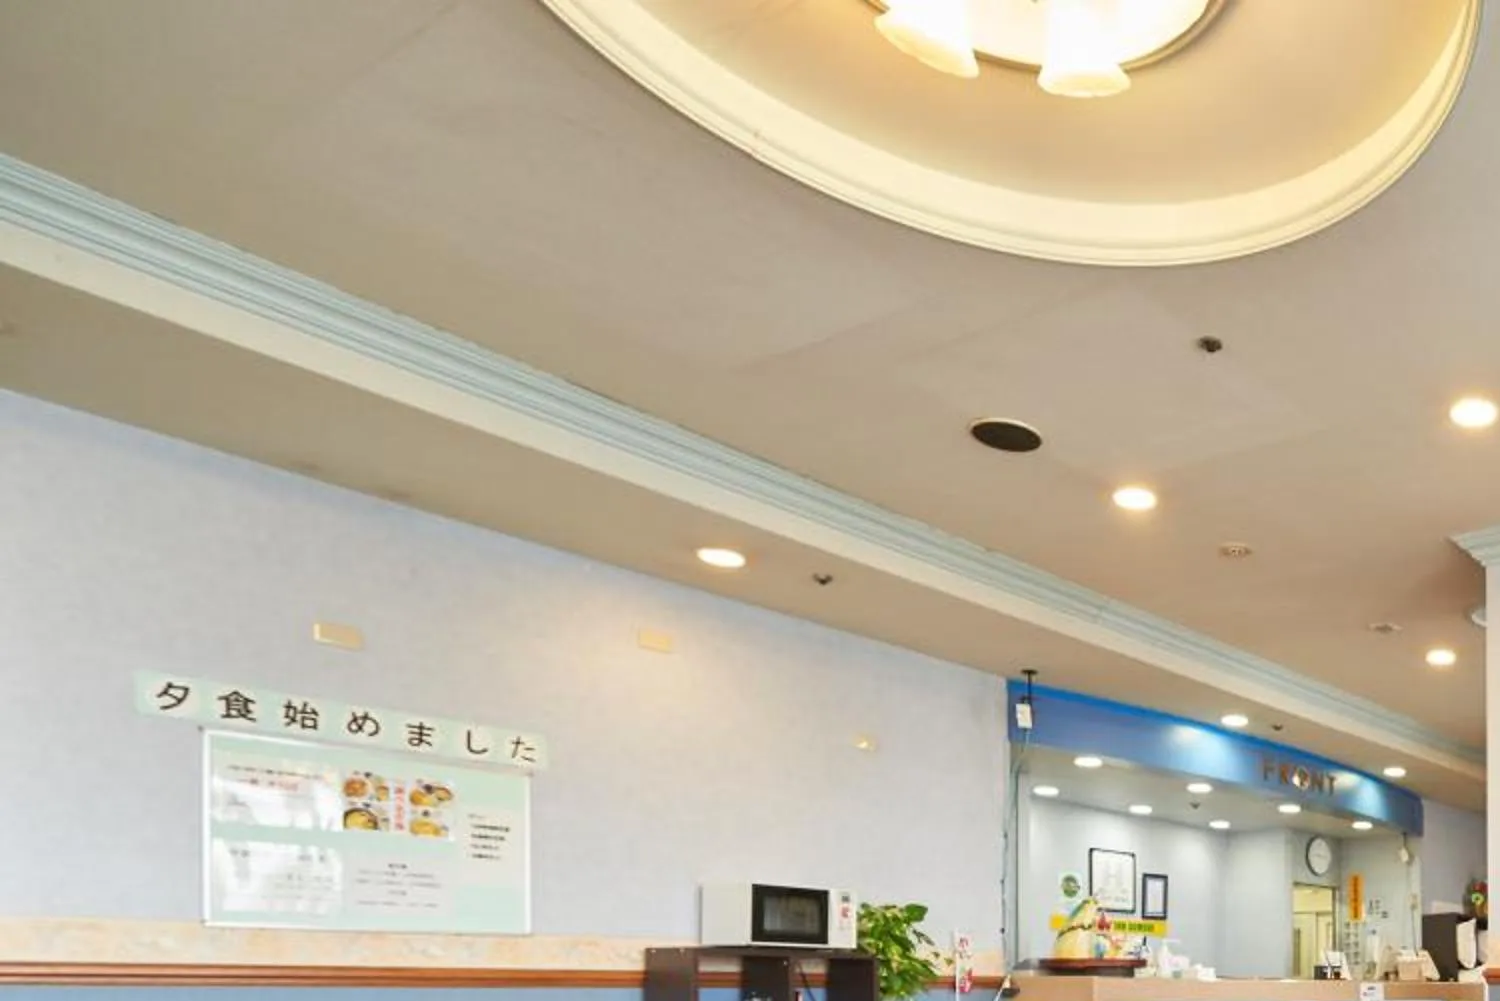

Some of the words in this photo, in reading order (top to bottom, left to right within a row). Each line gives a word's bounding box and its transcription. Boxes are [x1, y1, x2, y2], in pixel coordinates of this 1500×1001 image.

[156, 681, 538, 764] 夕食始めました
[1262, 757, 1336, 796] FRONT
